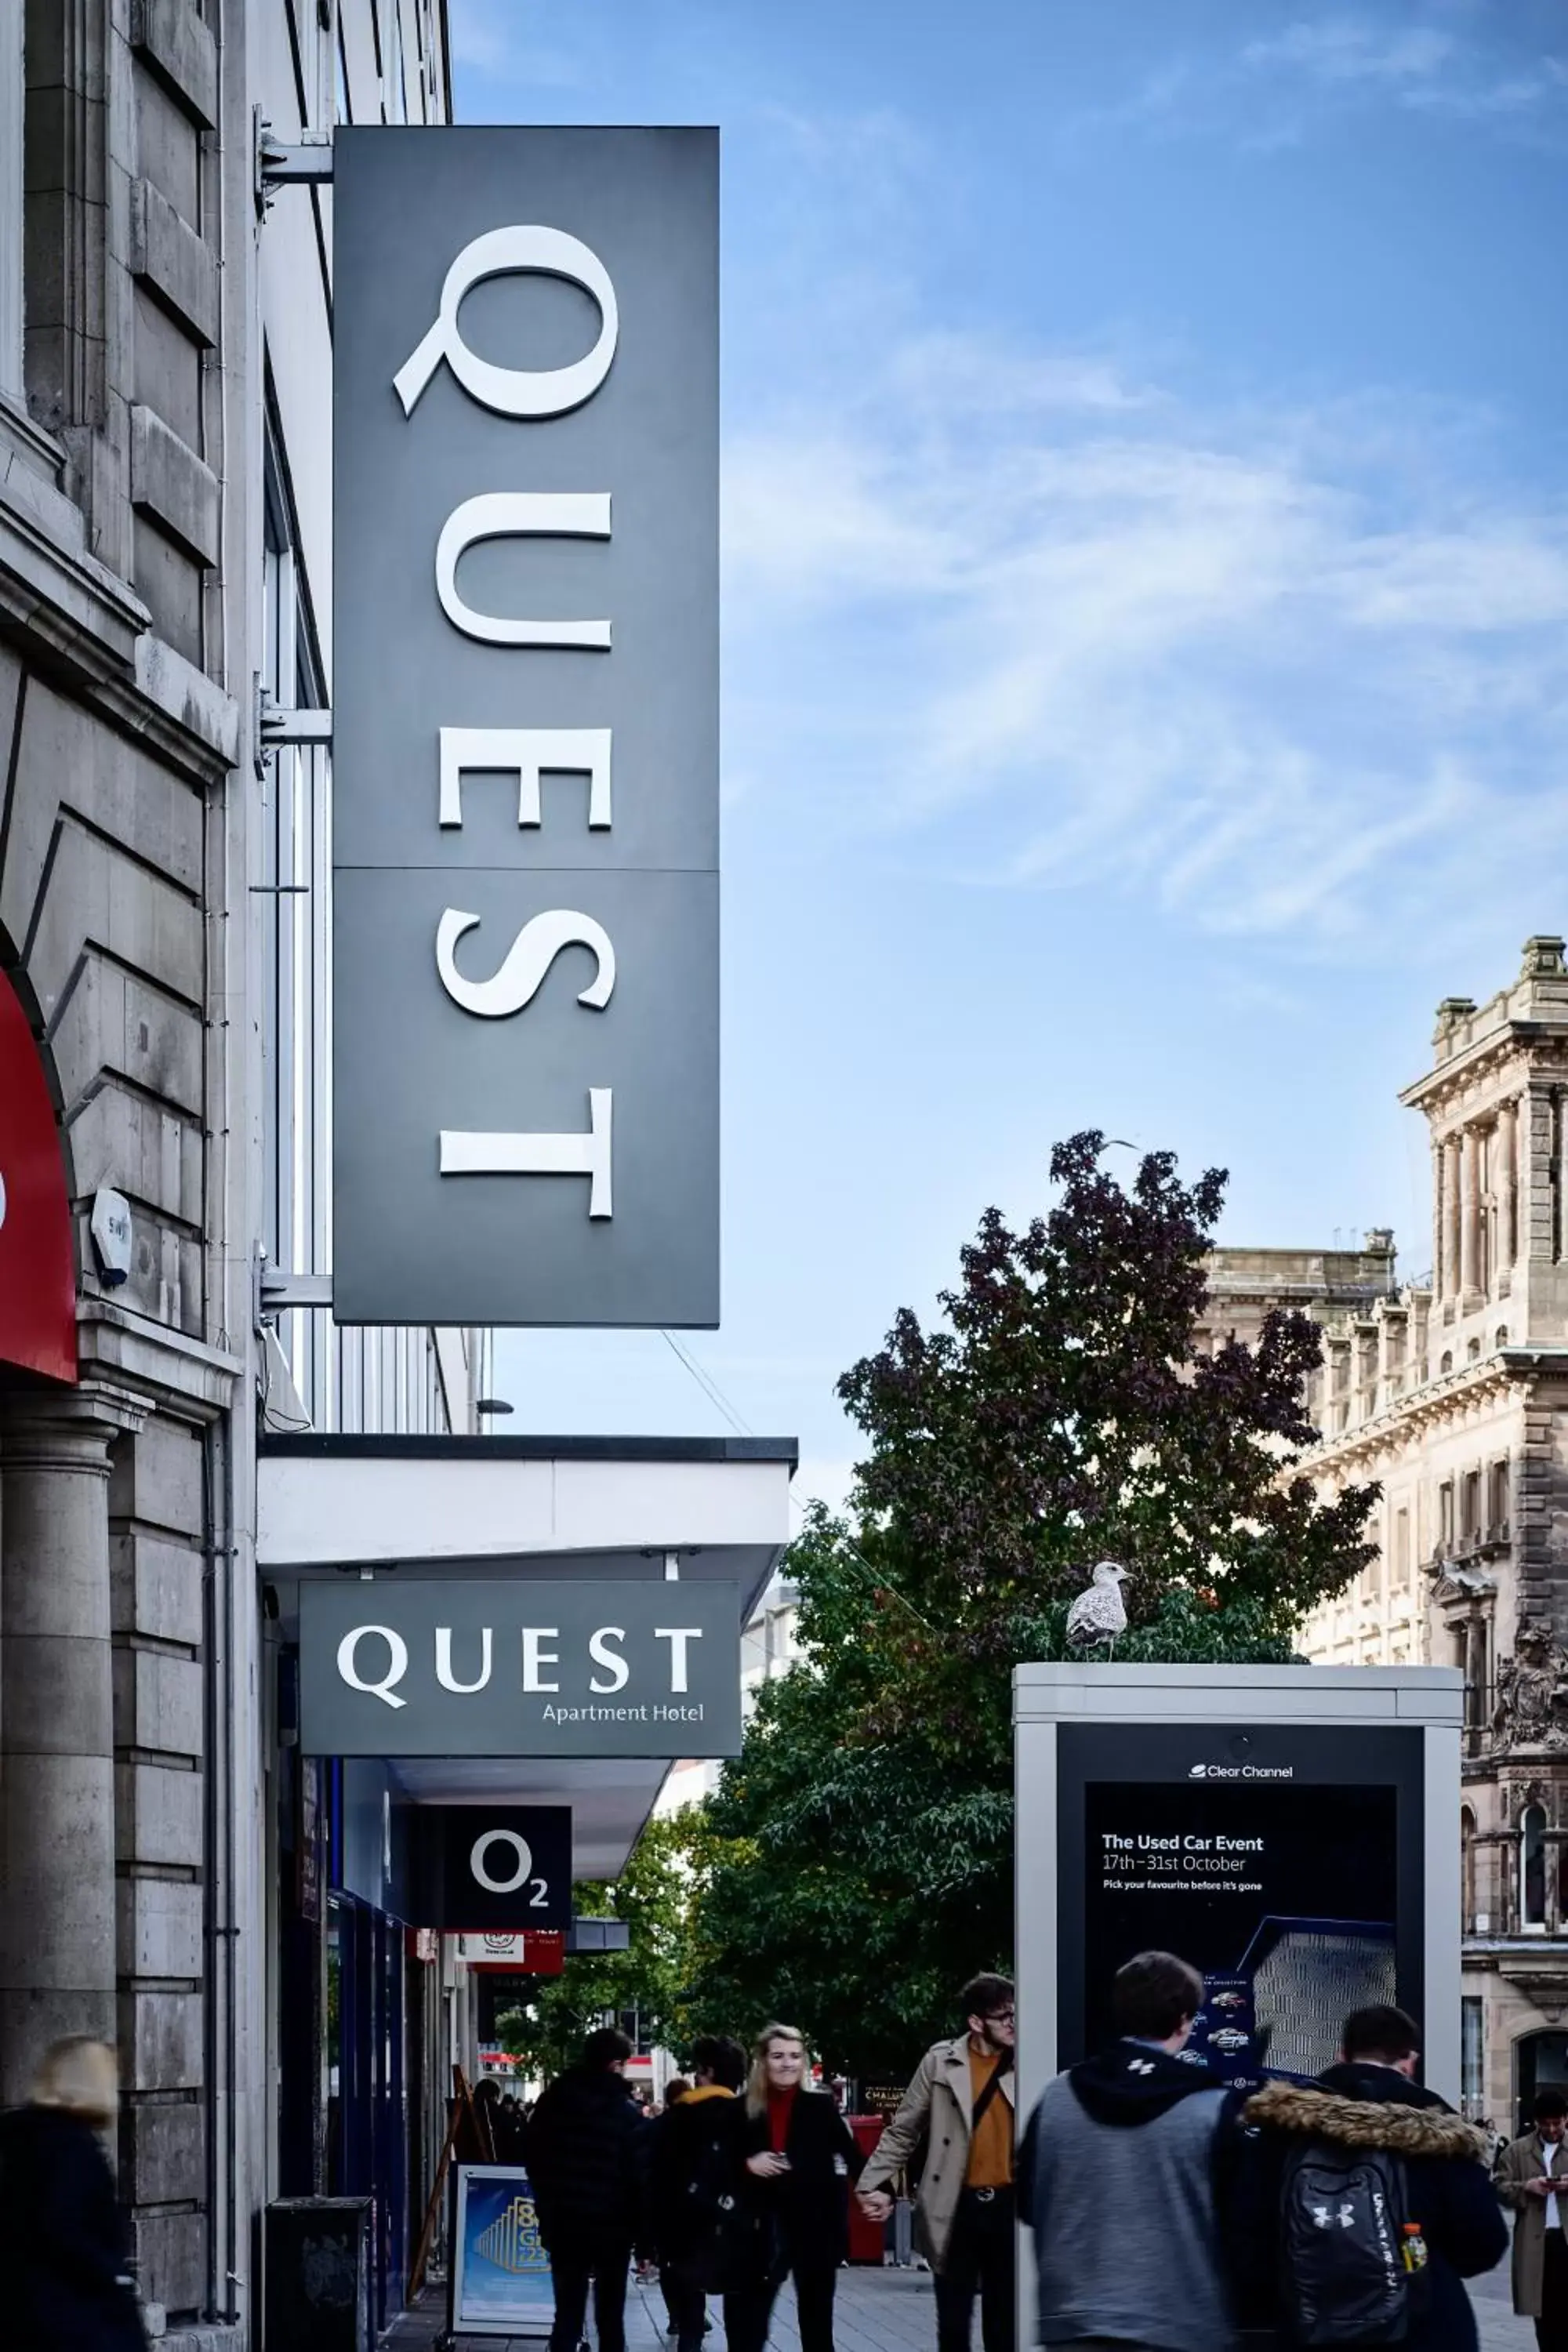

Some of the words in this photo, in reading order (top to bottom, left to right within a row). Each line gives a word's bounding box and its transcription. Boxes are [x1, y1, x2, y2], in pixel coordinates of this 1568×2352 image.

[394, 224, 619, 1220] QUEST
[336, 1624, 703, 1708] QUEST
[543, 1704, 648, 1725] Apartment
[654, 1704, 703, 1722] Hotel
[1207, 1765, 1240, 1777] Clear
[1242, 1765, 1293, 1777] Channel
[1102, 1834, 1134, 1849] The
[1138, 1835, 1180, 1850] Used
[1183, 1835, 1213, 1850] Car
[1216, 1835, 1265, 1851] Event
[470, 1829, 550, 1907] O2
[1183, 1855, 1247, 1871] October
[1103, 1879, 1123, 1889] Pick
[1124, 1881, 1145, 1891] your
[1147, 1879, 1189, 1890] favourite
[1191, 1880, 1221, 1890] before
[1238, 1882, 1263, 1892] gone
